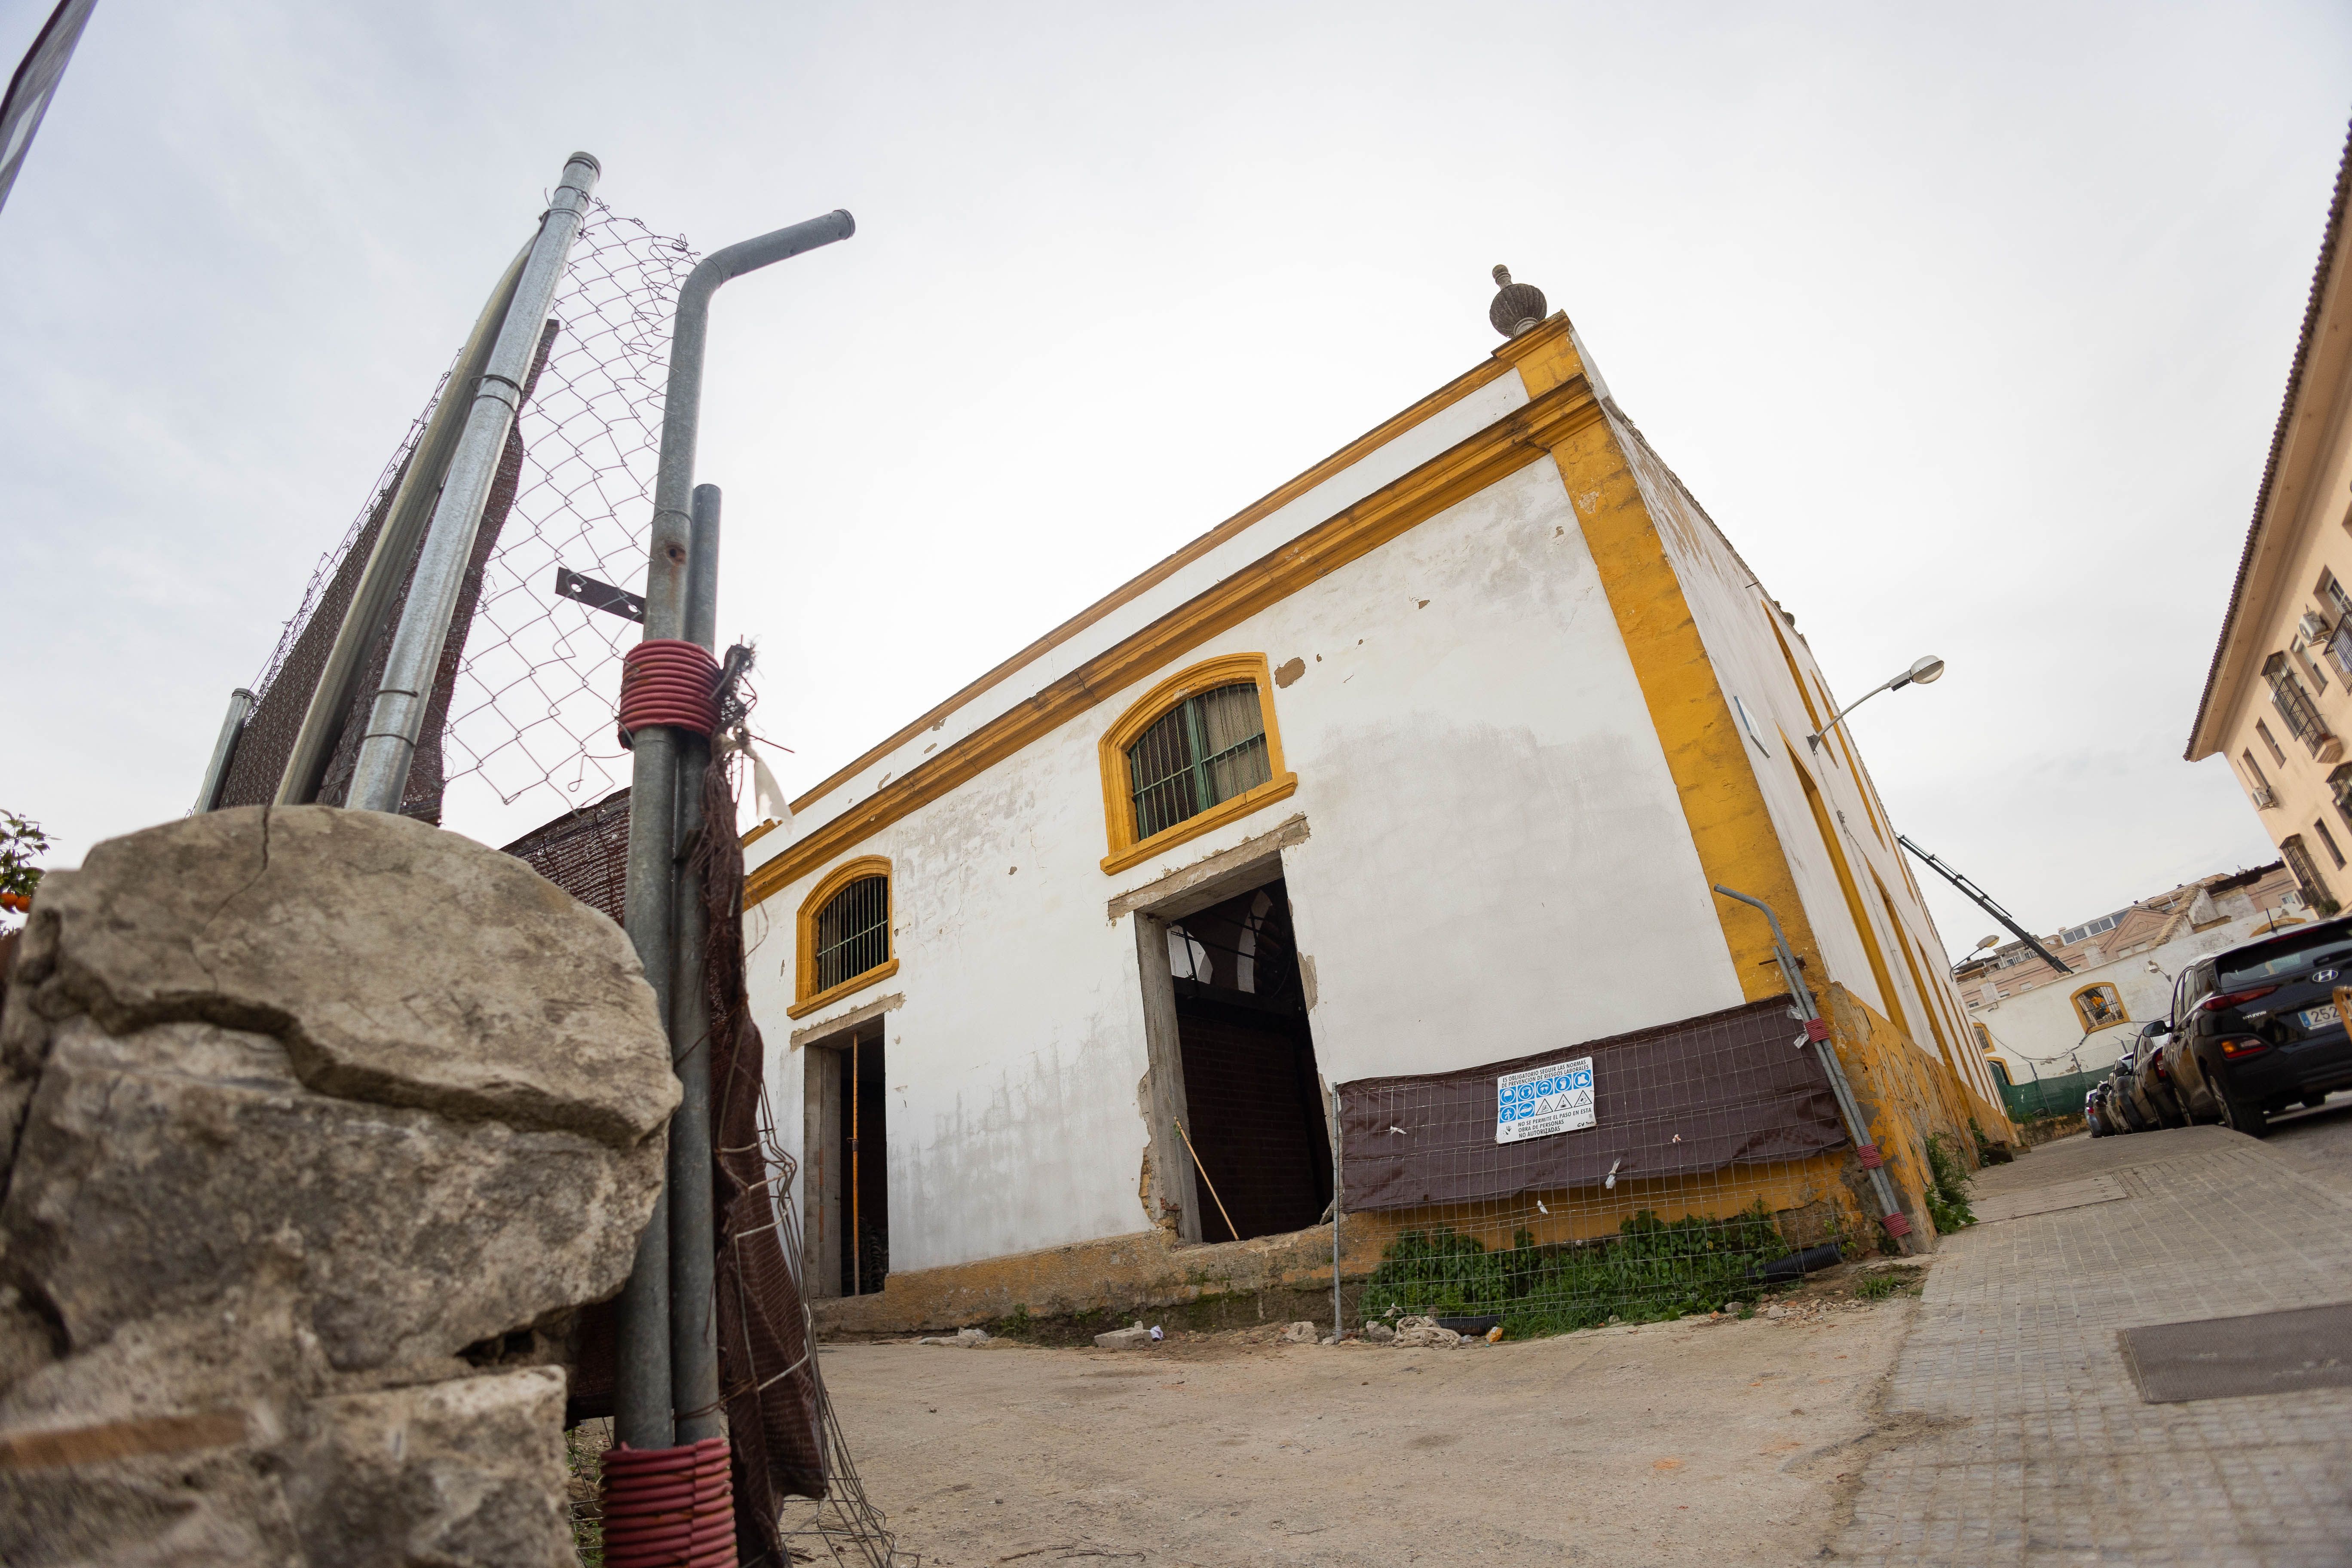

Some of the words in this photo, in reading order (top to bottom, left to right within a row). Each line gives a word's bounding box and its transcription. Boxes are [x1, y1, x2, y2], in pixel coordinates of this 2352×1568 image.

[2242, 1011, 2266, 1020] HYUNDAI
[2311, 1005, 2348, 1022] 252
[1509, 1071, 1538, 1081] OBLIGATORIO
[1566, 1060, 1586, 1068] NORMAS
[1509, 1077, 1536, 1087] PREVENCION
[1564, 1065, 1589, 1074] LABORALES
[1540, 1120, 1564, 1128] PERSONAS
[1528, 1126, 1560, 1136] AUTORIZADAS
